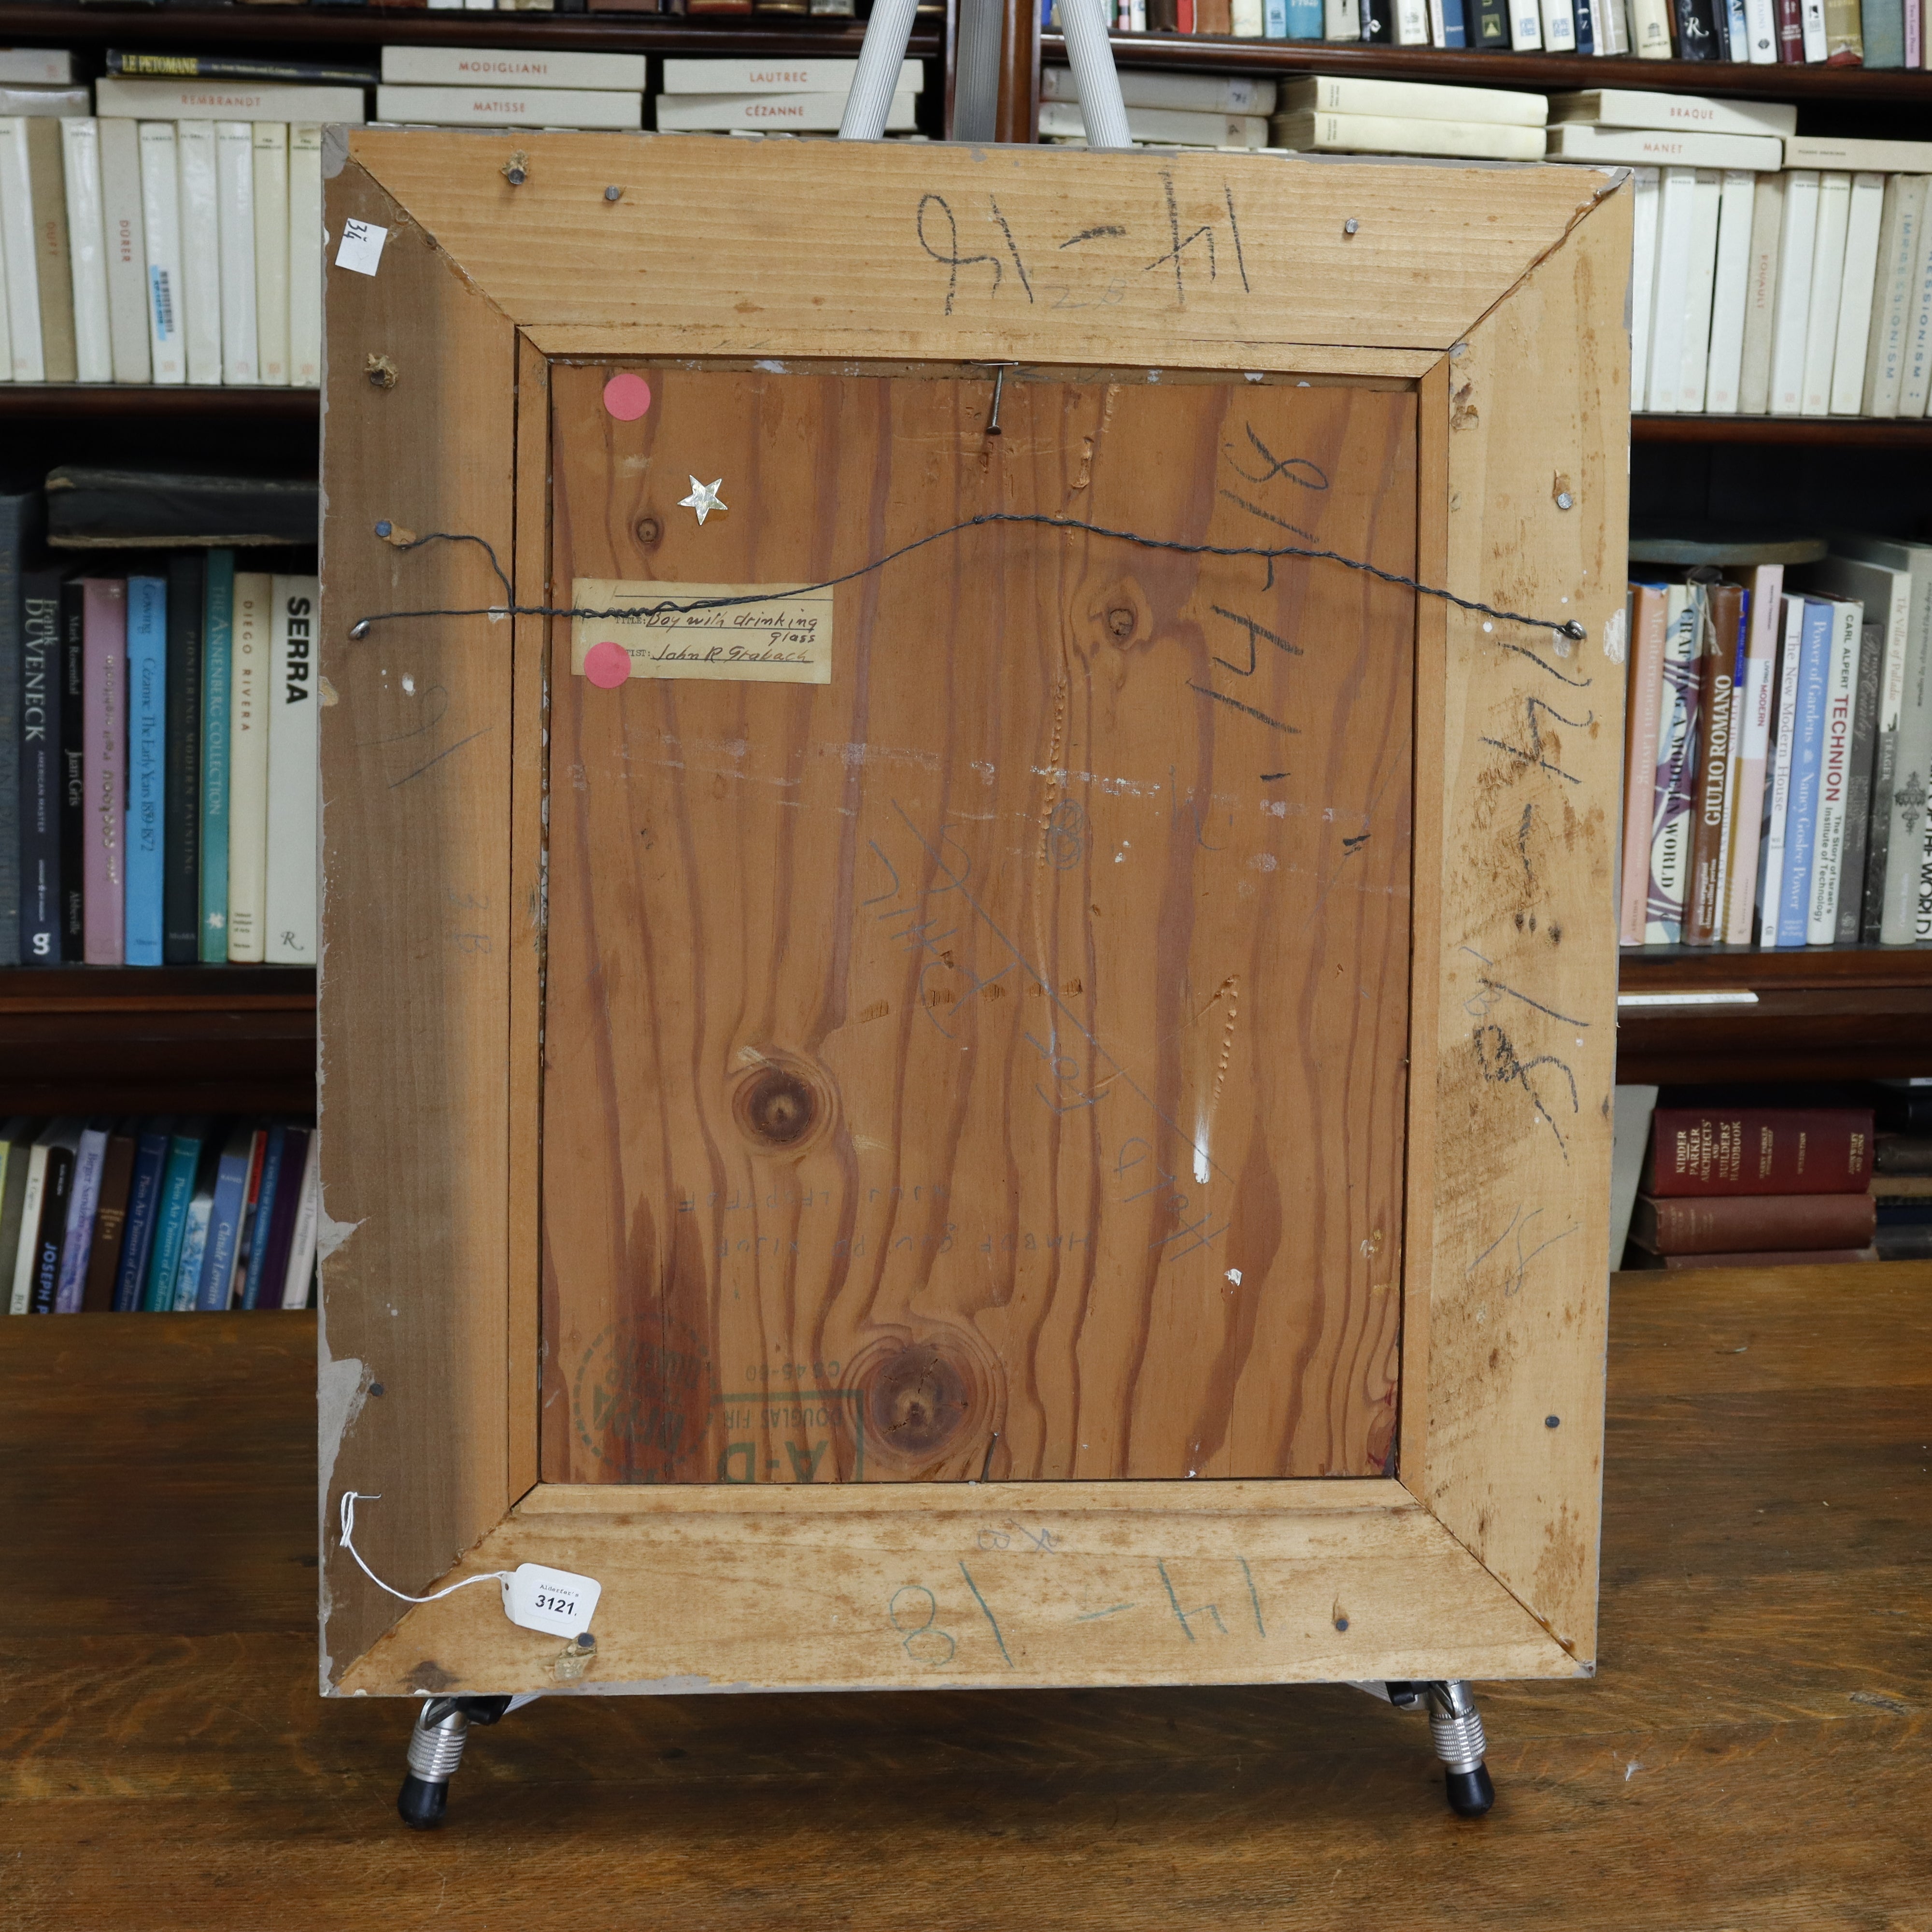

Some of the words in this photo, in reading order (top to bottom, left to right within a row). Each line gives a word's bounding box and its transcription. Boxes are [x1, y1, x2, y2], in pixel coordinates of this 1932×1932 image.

[1686, 17, 1709, 37] R
[122, 55, 137, 72] LE
[139, 56, 198, 75] PETOMANE
[458, 61, 549, 75] MODIGLIANI
[750, 71, 808, 84] LAUTREC
[181, 96, 260, 107] REMBRANDT
[473, 101, 526, 114] MATISSE
[745, 103, 804, 118] CÉZANNE
[1670, 107, 1714, 120] BRAQUE
[1644, 142, 1683, 154] MANET
[1887, 215, 1912, 379] IMPRESSIONISM
[43, 599, 57, 646] Frank
[140, 584, 156, 634] Gowing
[615, 616, 646, 625] TITLE:
[646, 611, 681, 632] Boy
[688, 610, 725, 627] with
[734, 609, 818, 632] drinking
[1896, 597, 1907, 613] The
[242, 600, 253, 655] DIEGO
[770, 631, 816, 645] glass
[1786, 633, 1800, 660] The
[1810, 620, 1827, 666] Power
[1844, 614, 1854, 644] CARL
[1894, 618, 1906, 646] Villas
[209, 615, 228, 715] ANNENBERG
[286, 596, 311, 705] SERRA
[652, 644, 701, 660] John
[703, 647, 723, 664] R
[1643, 608, 1664, 728] Mediterranean
[1673, 607, 1695, 709] CRAFTING
[1839, 647, 1850, 689] ALPERT
[1891, 650, 1902, 660] of
[25, 598, 45, 742] DUVENECK
[69, 646, 80, 695] Rosenthal
[186, 631, 196, 724] PIONEERING
[1784, 666, 1797, 697] New
[1809, 668, 1824, 683] of
[1889, 663, 1902, 701] Palladio
[241, 669, 252, 732] RIVERA
[1710, 675, 1732, 759] ROMANO
[1757, 684, 1767, 727] MODERN
[1804, 684, 1821, 744] Gardens
[1673, 715, 1687, 728] A
[1778, 702, 1795, 759] Modern
[66, 749, 82, 777] Juan
[140, 738, 156, 768] Early
[185, 733, 195, 795] MODERN
[1638, 733, 1657, 785] Living
[1825, 695, 1849, 802] TECHNION
[1882, 737, 1893, 781] TRAGER
[209, 721, 224, 815] COLLECTION
[1665, 735, 1686, 815] MODERN
[67, 778, 83, 807] Gris
[1705, 763, 1726, 826] GIULIO
[1775, 765, 1790, 812] House
[1794, 772, 1815, 813] Nancy
[1793, 816, 1810, 864] Goslee
[1821, 806, 1833, 848] Institute
[1833, 815, 1842, 835] The
[1661, 822, 1680, 889] WORLD
[1820, 851, 1830, 862] of
[1830, 837, 1840, 862] Story
[1788, 866, 1805, 910] Power
[1829, 864, 1839, 874] of
[1813, 865, 1829, 923] Technology
[1825, 876, 1837, 914] Israel's
[281, 932, 304, 952] R
[1676, 1131, 1687, 1174] KIDDER
[1690, 1127, 1700, 1176] PARKER
[1700, 1119, 1711, 1182] ARCHITECTS'
[1719, 1122, 1732, 1179] BUILDERS'
[1730, 1121, 1741, 1181] HANDBOOK
[1760, 1126, 1768, 1155] PARKER
[1849, 1132, 1859, 1156] WILEY
[1857, 1134, 1865, 1154] SONS
[172, 1177, 185, 1200] Plein
[135, 1201, 146, 1216] Air
[170, 1202, 181, 1218] Air
[129, 1219, 144, 1256] Painters
[164, 1221, 178, 1257] Painters
[213, 1221, 231, 1261] Claude
[40, 1242, 57, 1302] JOSEPH
[127, 1259, 136, 1267] of
[161, 1259, 171, 1270] of
[208, 1262, 225, 1304] Lorrain
[724, 1408, 751, 1430] FIR
[760, 1406, 845, 1431] DOUGLAS
[717, 1441, 829, 1484] A-D
[539, 1584, 579, 1597] Alderfer's
